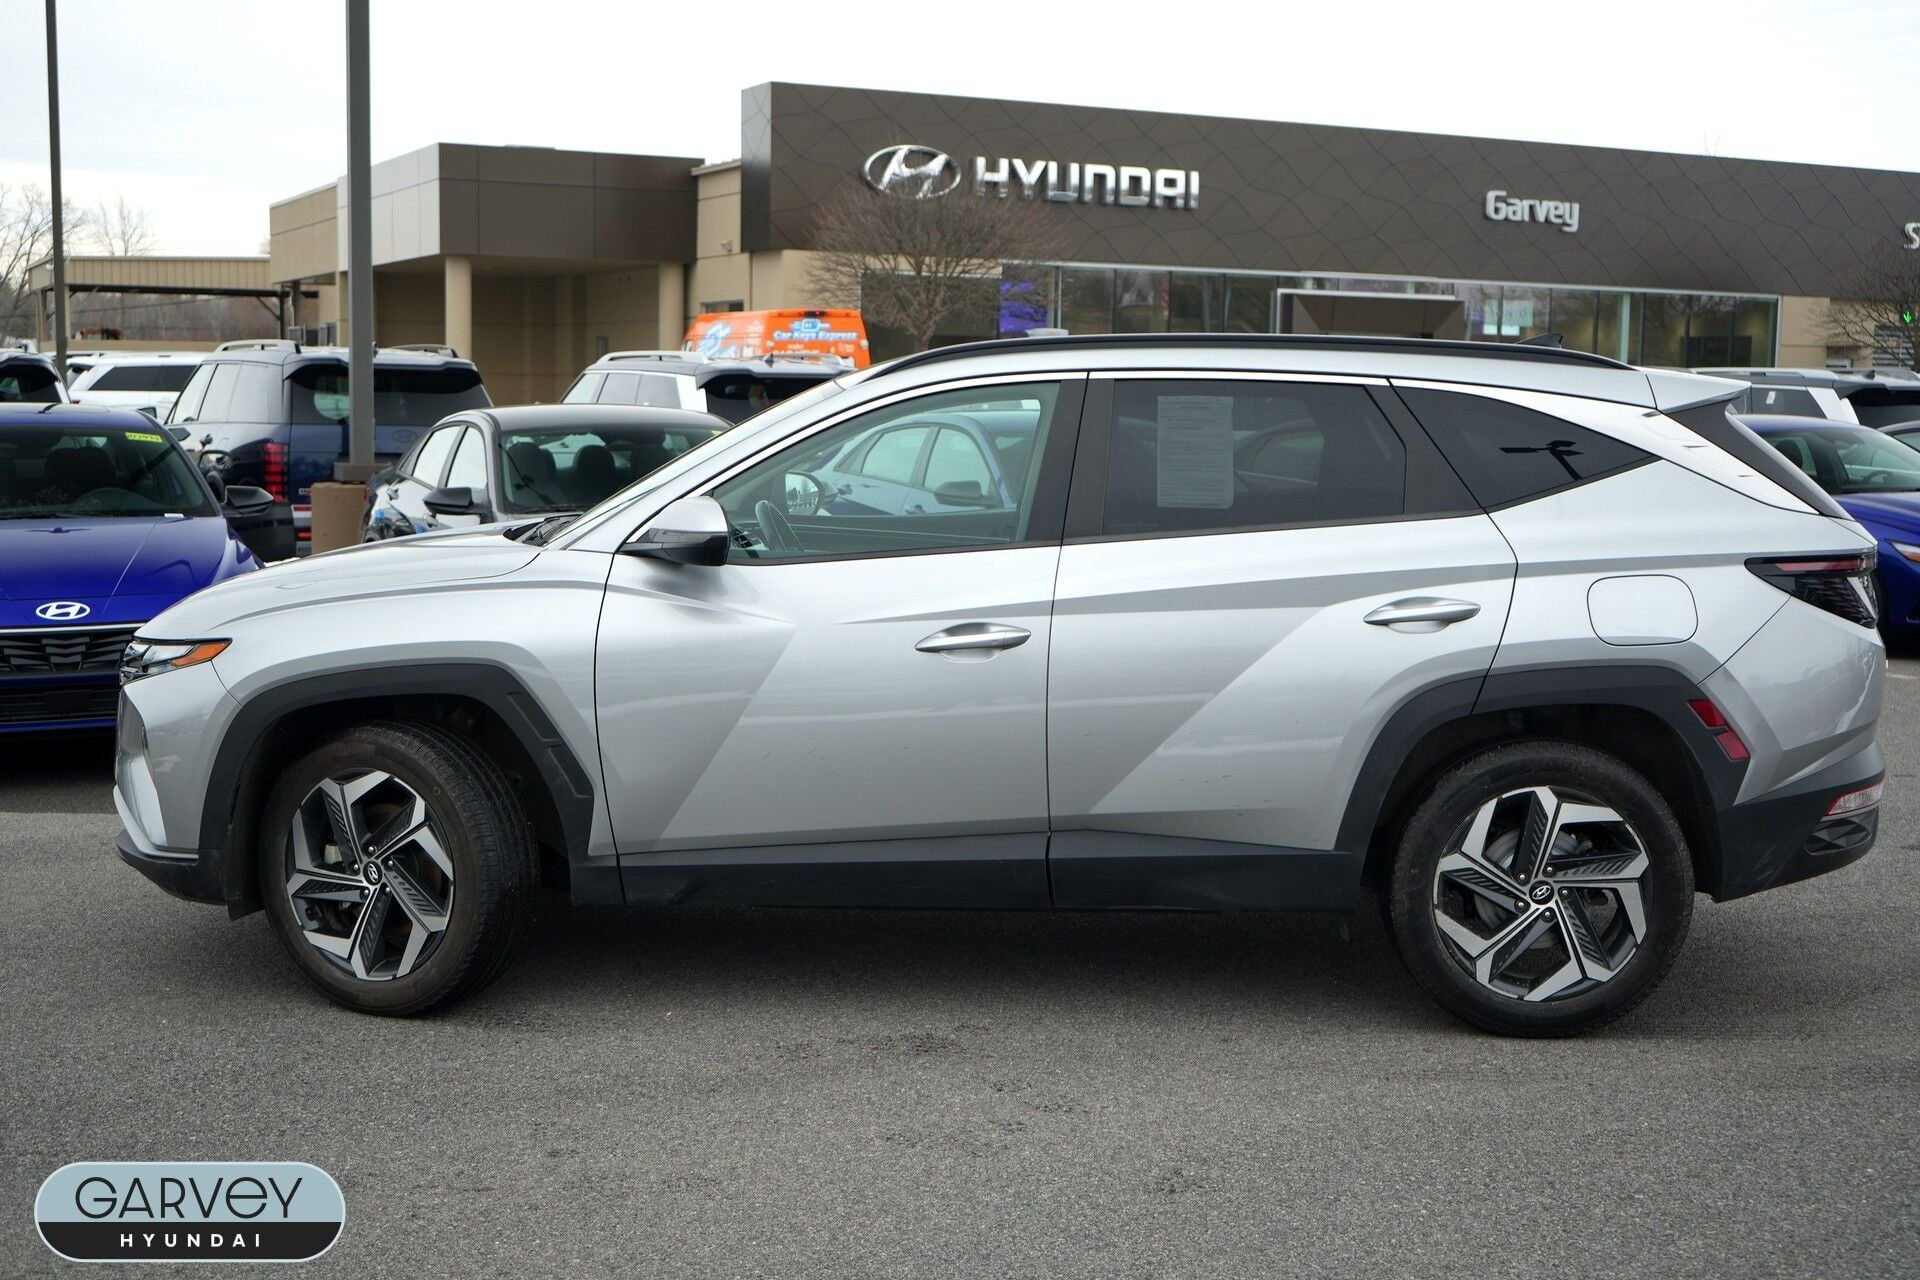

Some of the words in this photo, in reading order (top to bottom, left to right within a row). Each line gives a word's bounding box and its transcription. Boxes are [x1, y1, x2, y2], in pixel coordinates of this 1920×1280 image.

[975, 156, 1200, 209] HYUNDAI
[1486, 190, 1580, 232] Garvey
[774, 331, 793, 341] Car
[793, 331, 817, 342] Keys
[818, 331, 858, 342] Express
